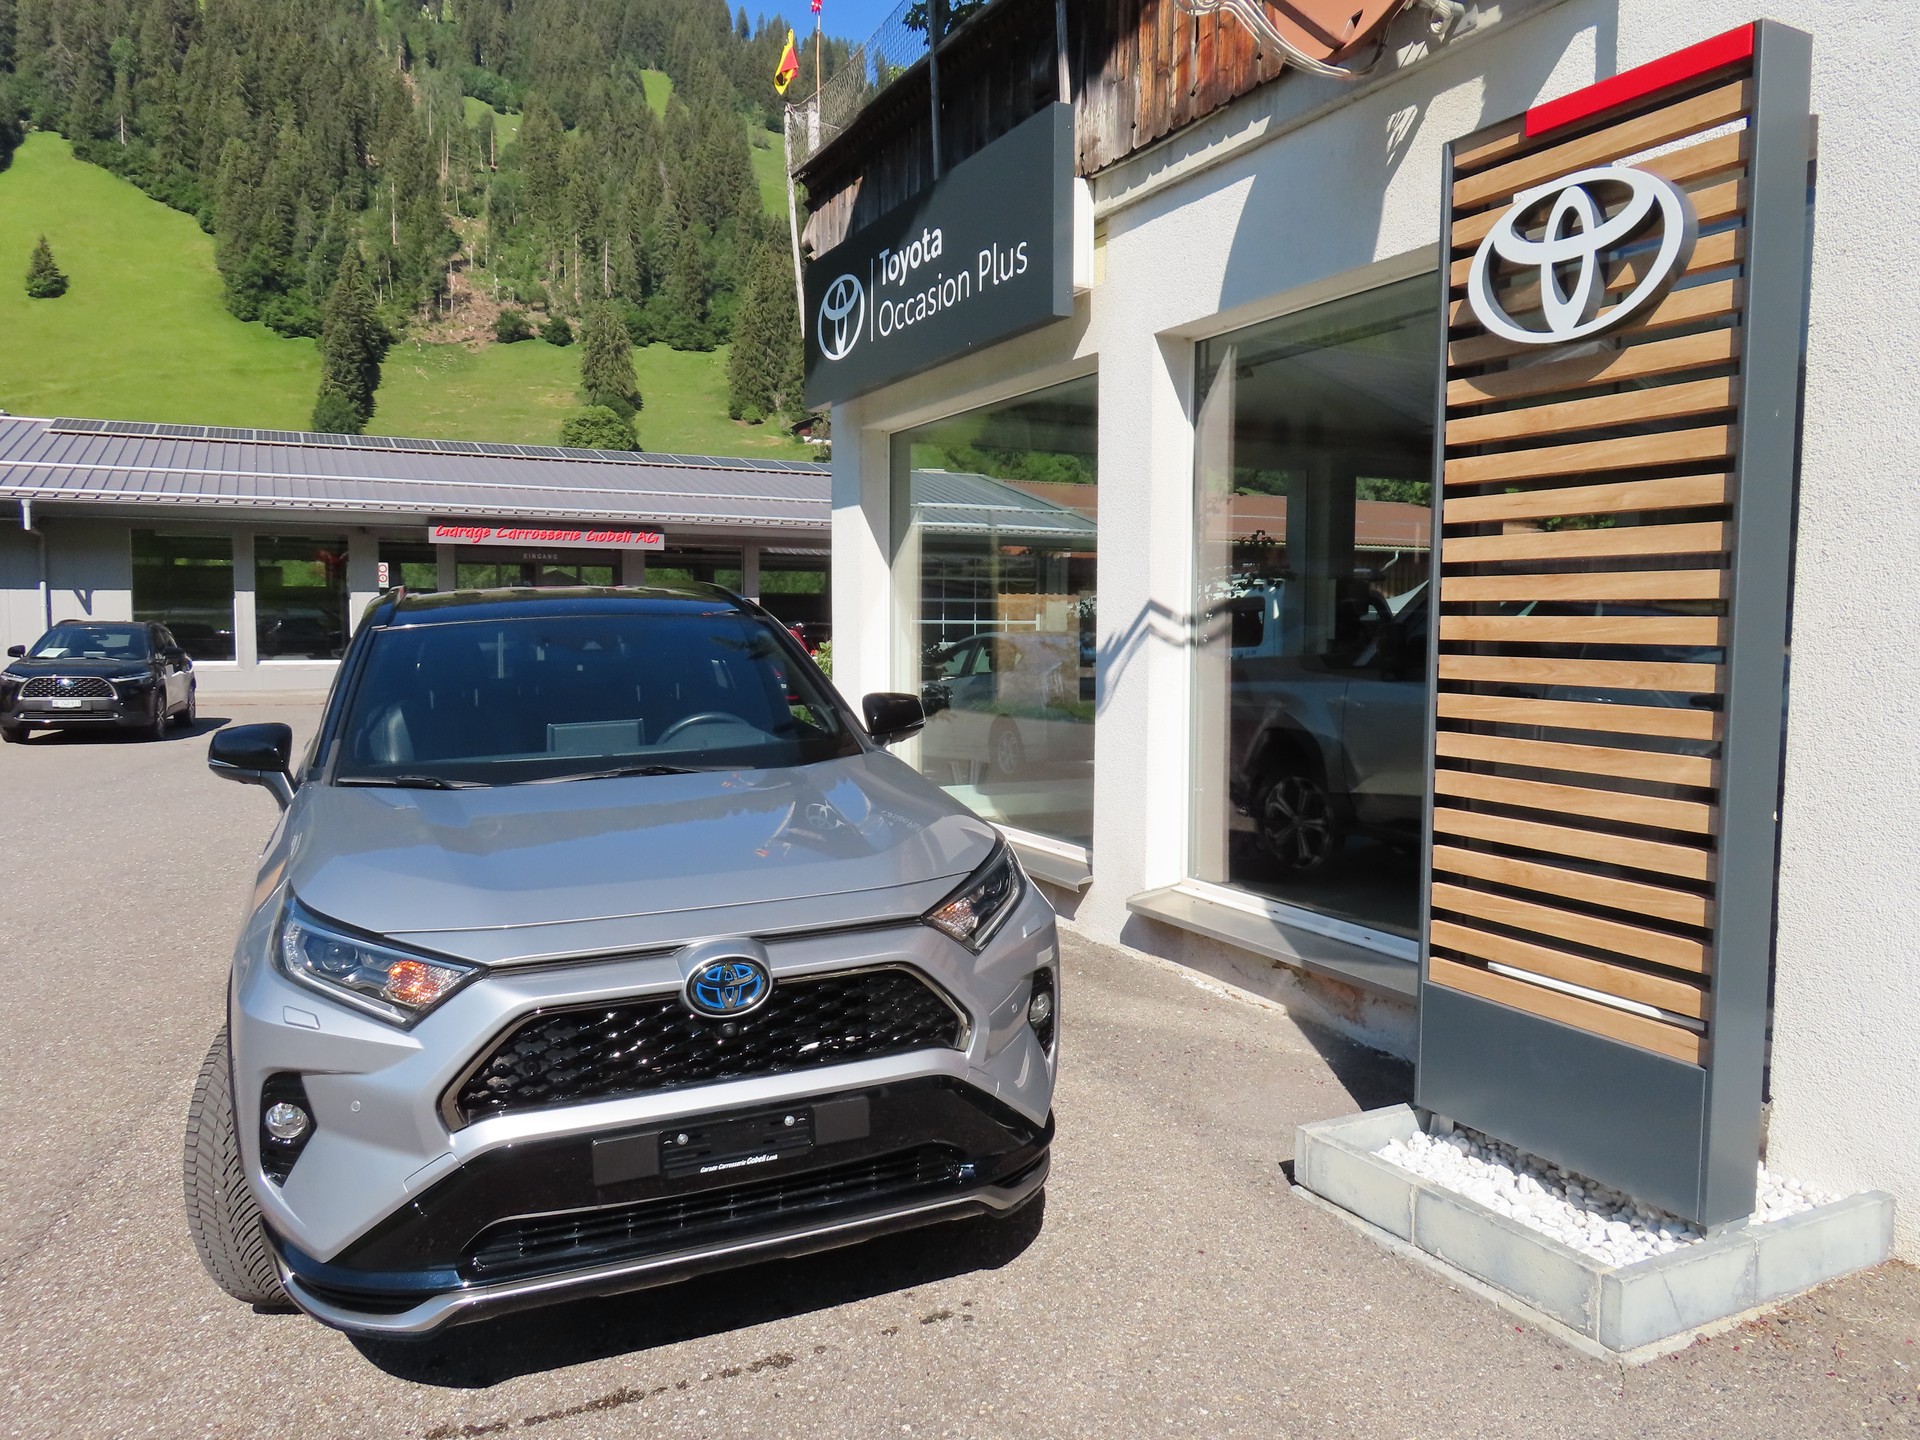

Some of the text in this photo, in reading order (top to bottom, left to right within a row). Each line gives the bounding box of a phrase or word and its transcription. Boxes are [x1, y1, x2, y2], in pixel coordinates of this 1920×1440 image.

[879, 227, 943, 286] Toyota
[879, 241, 1028, 337] Occasion Plus
[434, 524, 659, 543] Garage Carrosserie Gobeli AG
